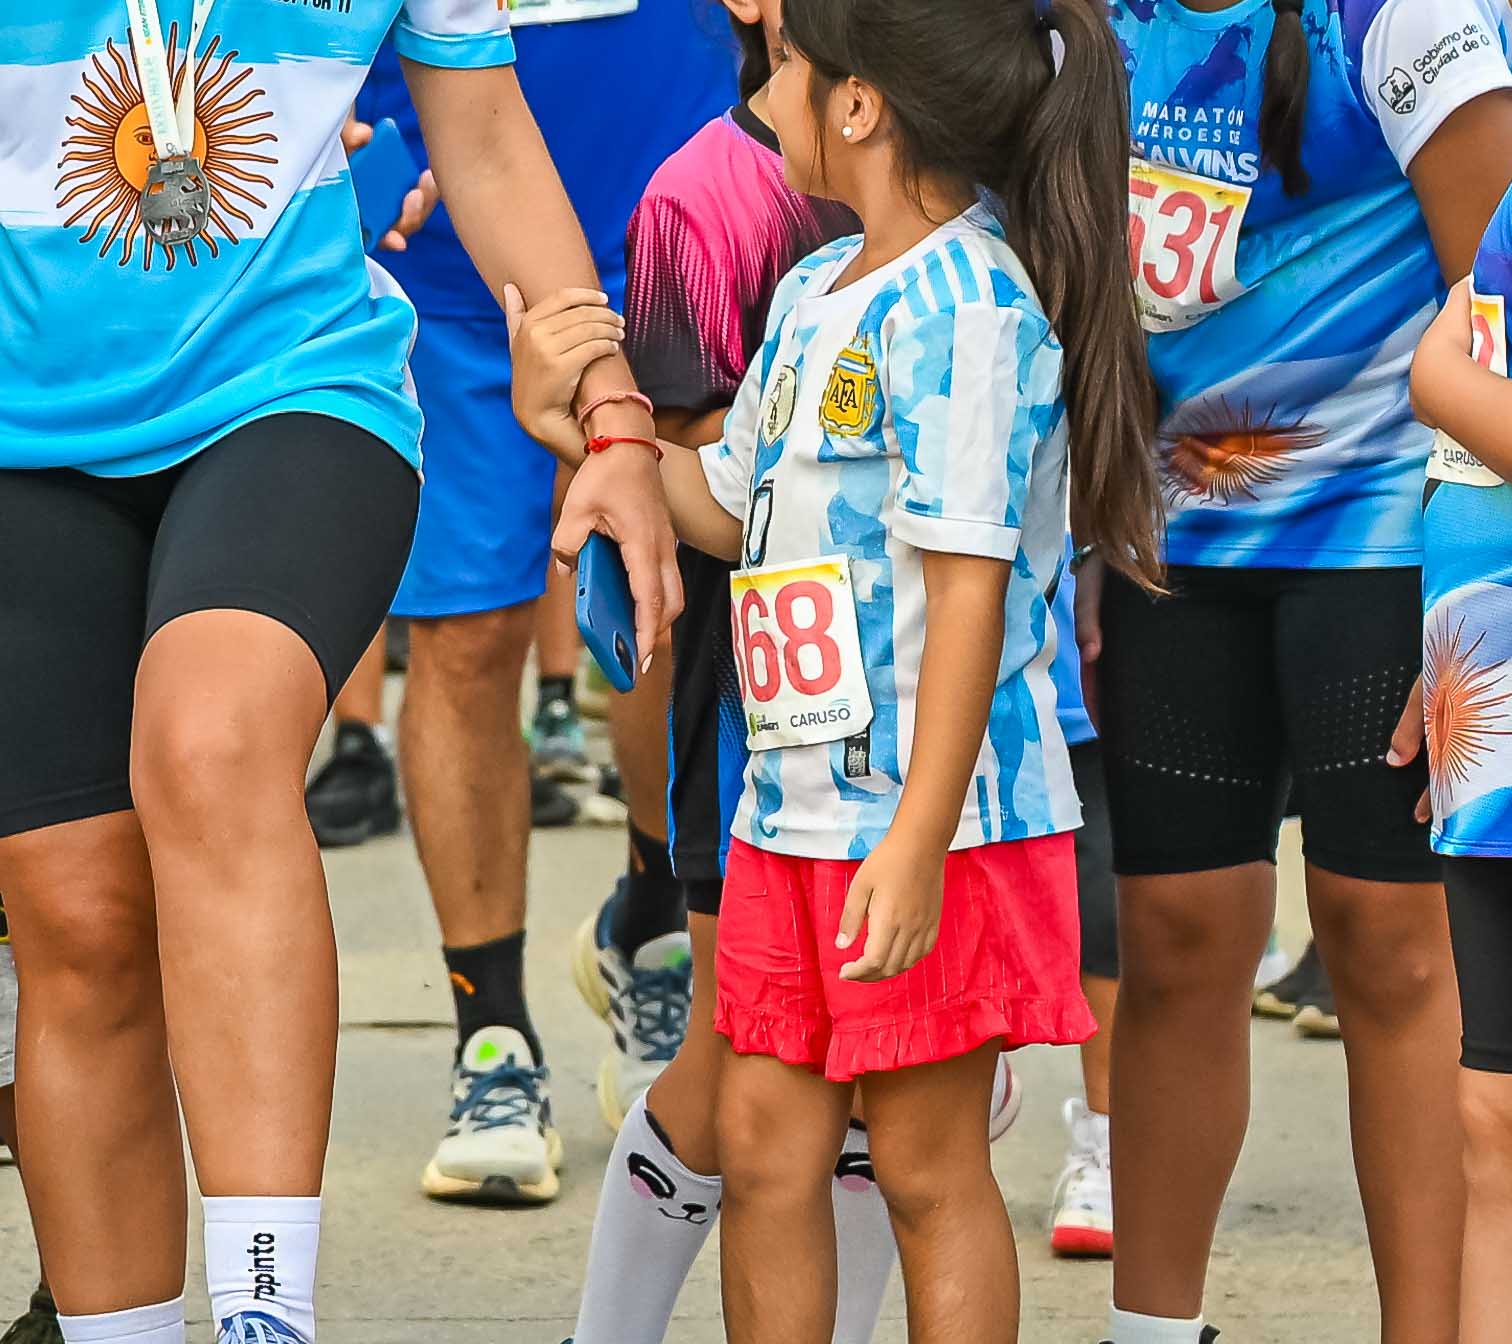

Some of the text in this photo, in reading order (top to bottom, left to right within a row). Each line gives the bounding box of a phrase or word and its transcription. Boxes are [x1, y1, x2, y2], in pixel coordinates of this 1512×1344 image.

[1462, 39, 1480, 53] de
[1142, 100, 1245, 127] MARATÓN
[731, 579, 843, 705] 68
[789, 706, 851, 729] CARUSO
